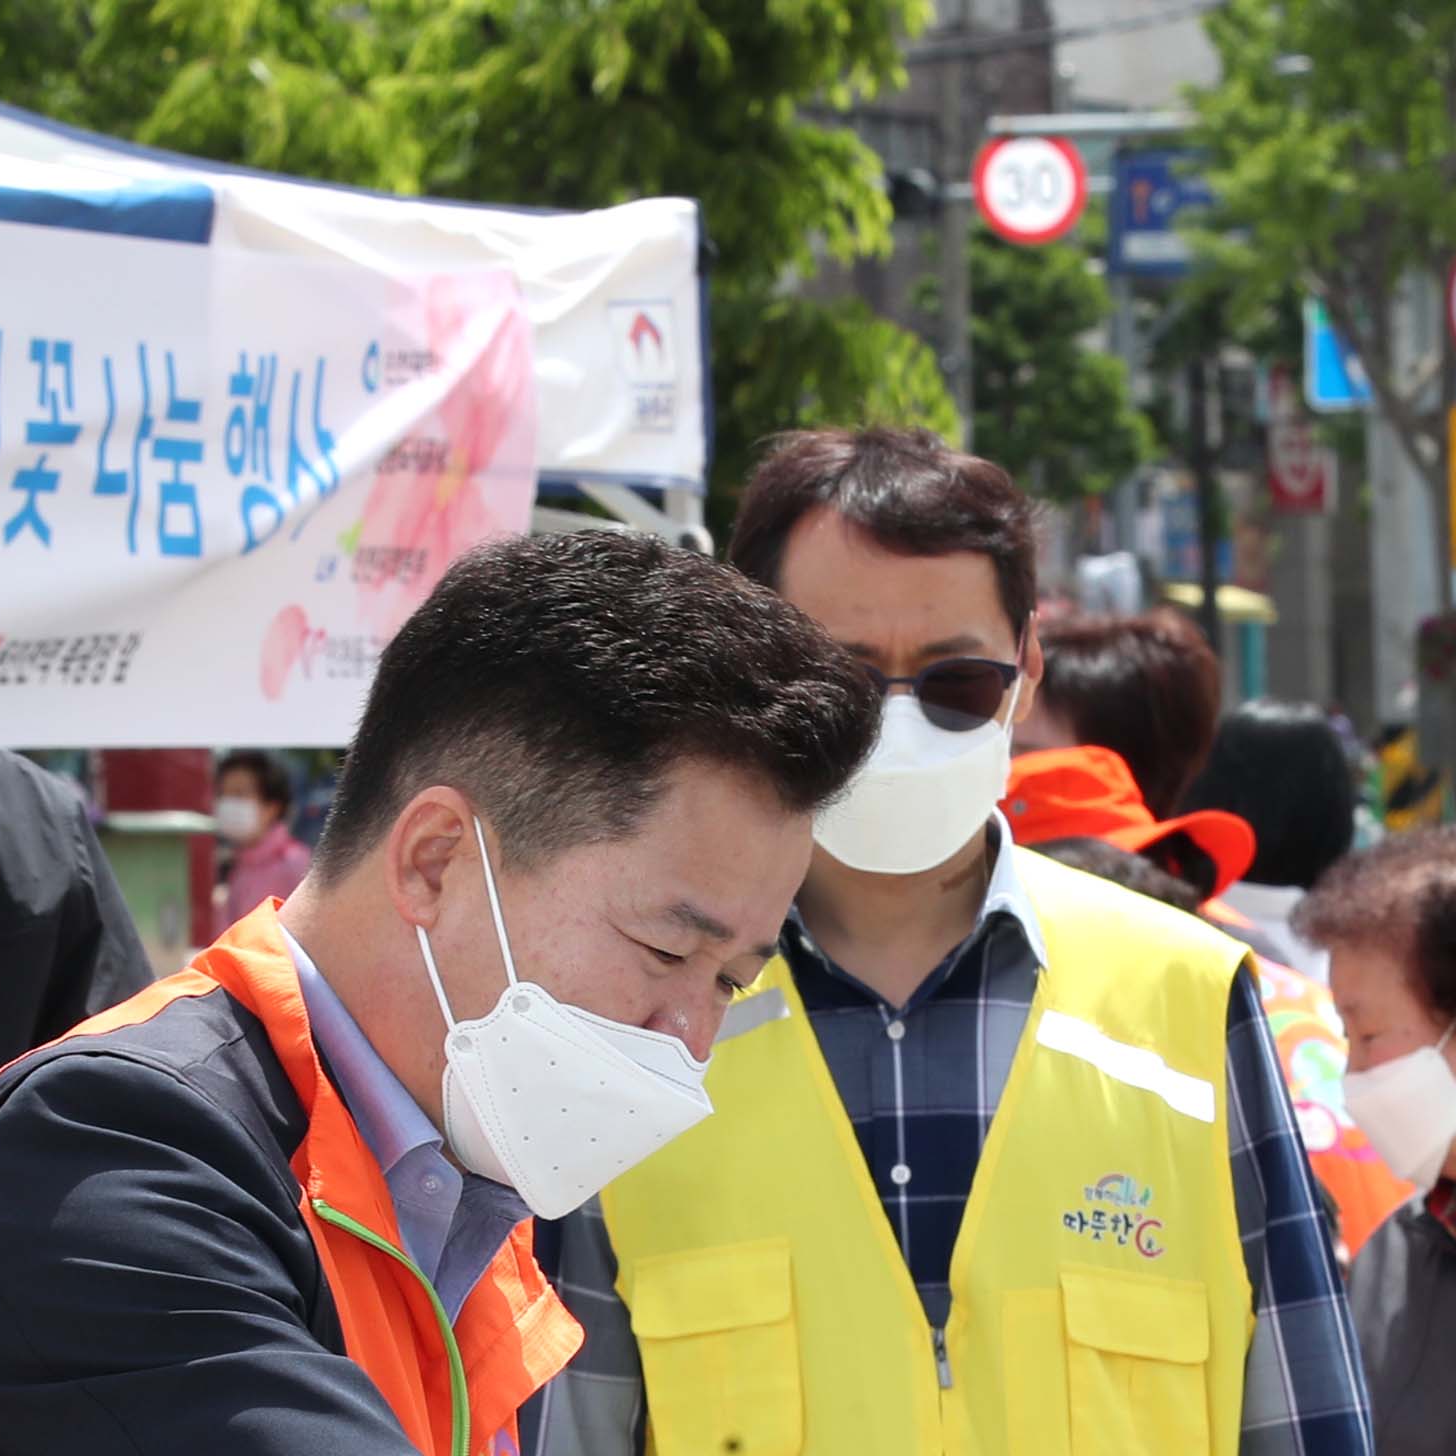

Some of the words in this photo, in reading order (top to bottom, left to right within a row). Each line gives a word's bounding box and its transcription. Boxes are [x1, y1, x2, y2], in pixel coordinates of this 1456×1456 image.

[999, 160, 1057, 211] 30
[3, 338, 83, 548] 꽃
[93, 341, 205, 558] 나눔
[224, 350, 342, 556] 행사
